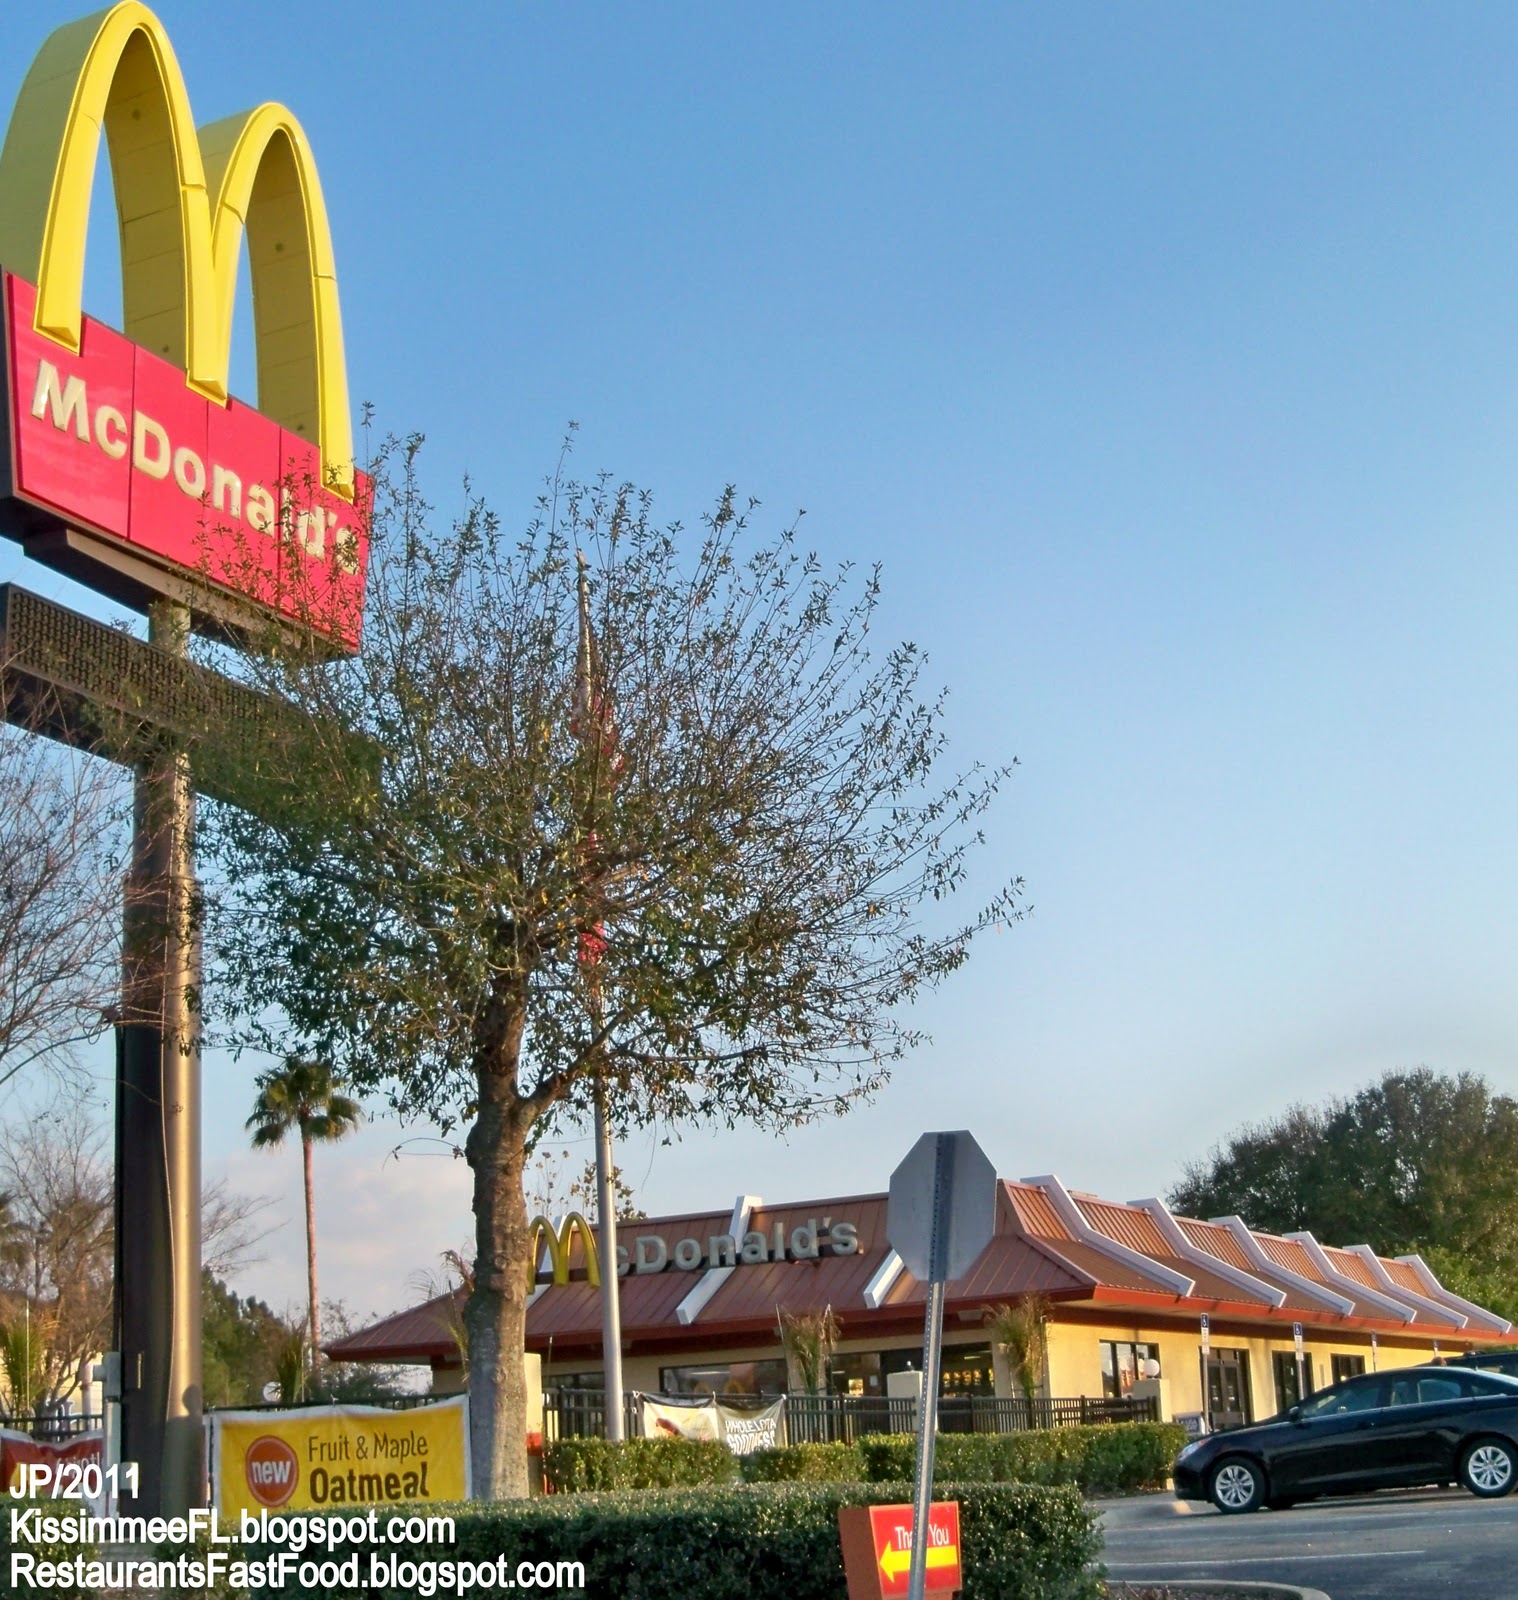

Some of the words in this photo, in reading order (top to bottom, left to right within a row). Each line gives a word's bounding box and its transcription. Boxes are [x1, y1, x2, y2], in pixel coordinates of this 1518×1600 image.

[31, 357, 360, 576] McDonald's
[724, 1419, 756, 1434] WHOLE
[308, 1436, 350, 1462] Fruit
[355, 1436, 369, 1460] &
[373, 1430, 429, 1464] Maple
[251, 1459, 292, 1484] new
[309, 1461, 430, 1504] Oatmeal
[928, 1523, 950, 1547] You
